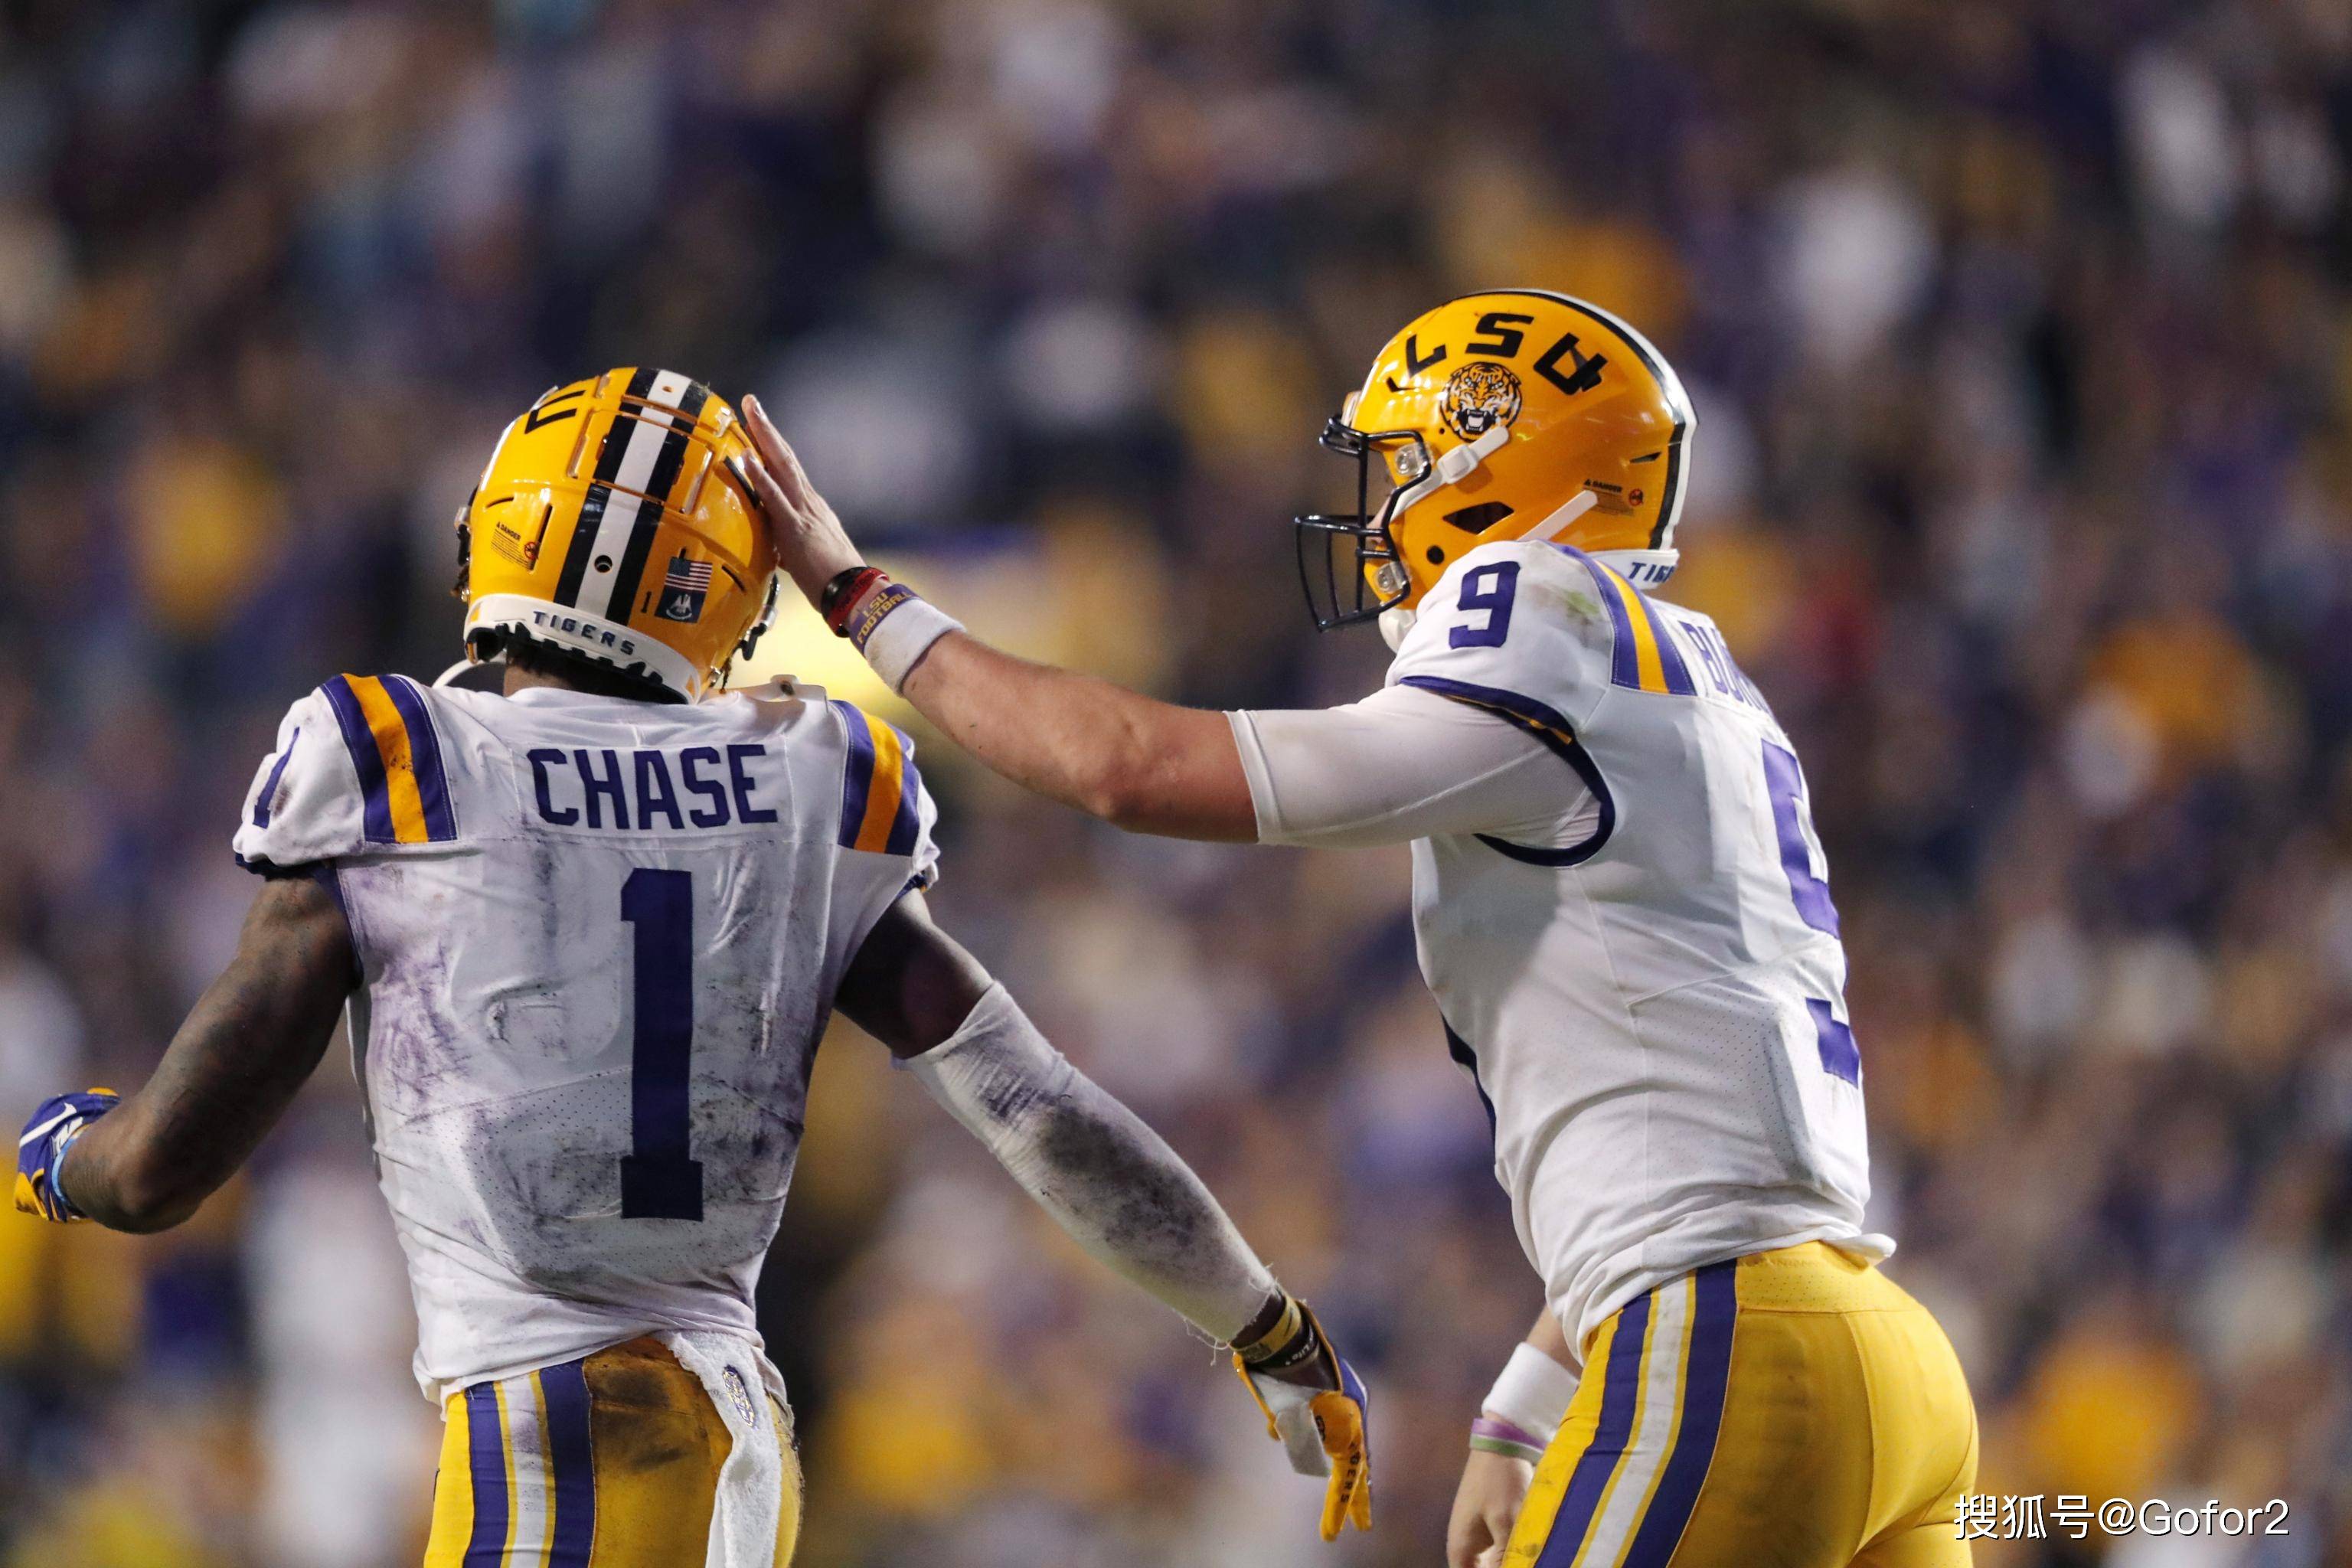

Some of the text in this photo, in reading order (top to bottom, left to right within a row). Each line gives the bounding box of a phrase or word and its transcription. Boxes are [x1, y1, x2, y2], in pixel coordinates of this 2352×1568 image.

[1406, 312, 1608, 396] LSU
[534, 610, 635, 656] TIGERS
[641, 590, 652, 614] 1
[857, 591, 912, 645] FOOTBALL
[864, 592, 890, 618] LSU
[1449, 560, 1521, 649] 9
[251, 726, 301, 830] 1
[527, 743, 779, 831] CHASE
[620, 867, 704, 1223] 1
